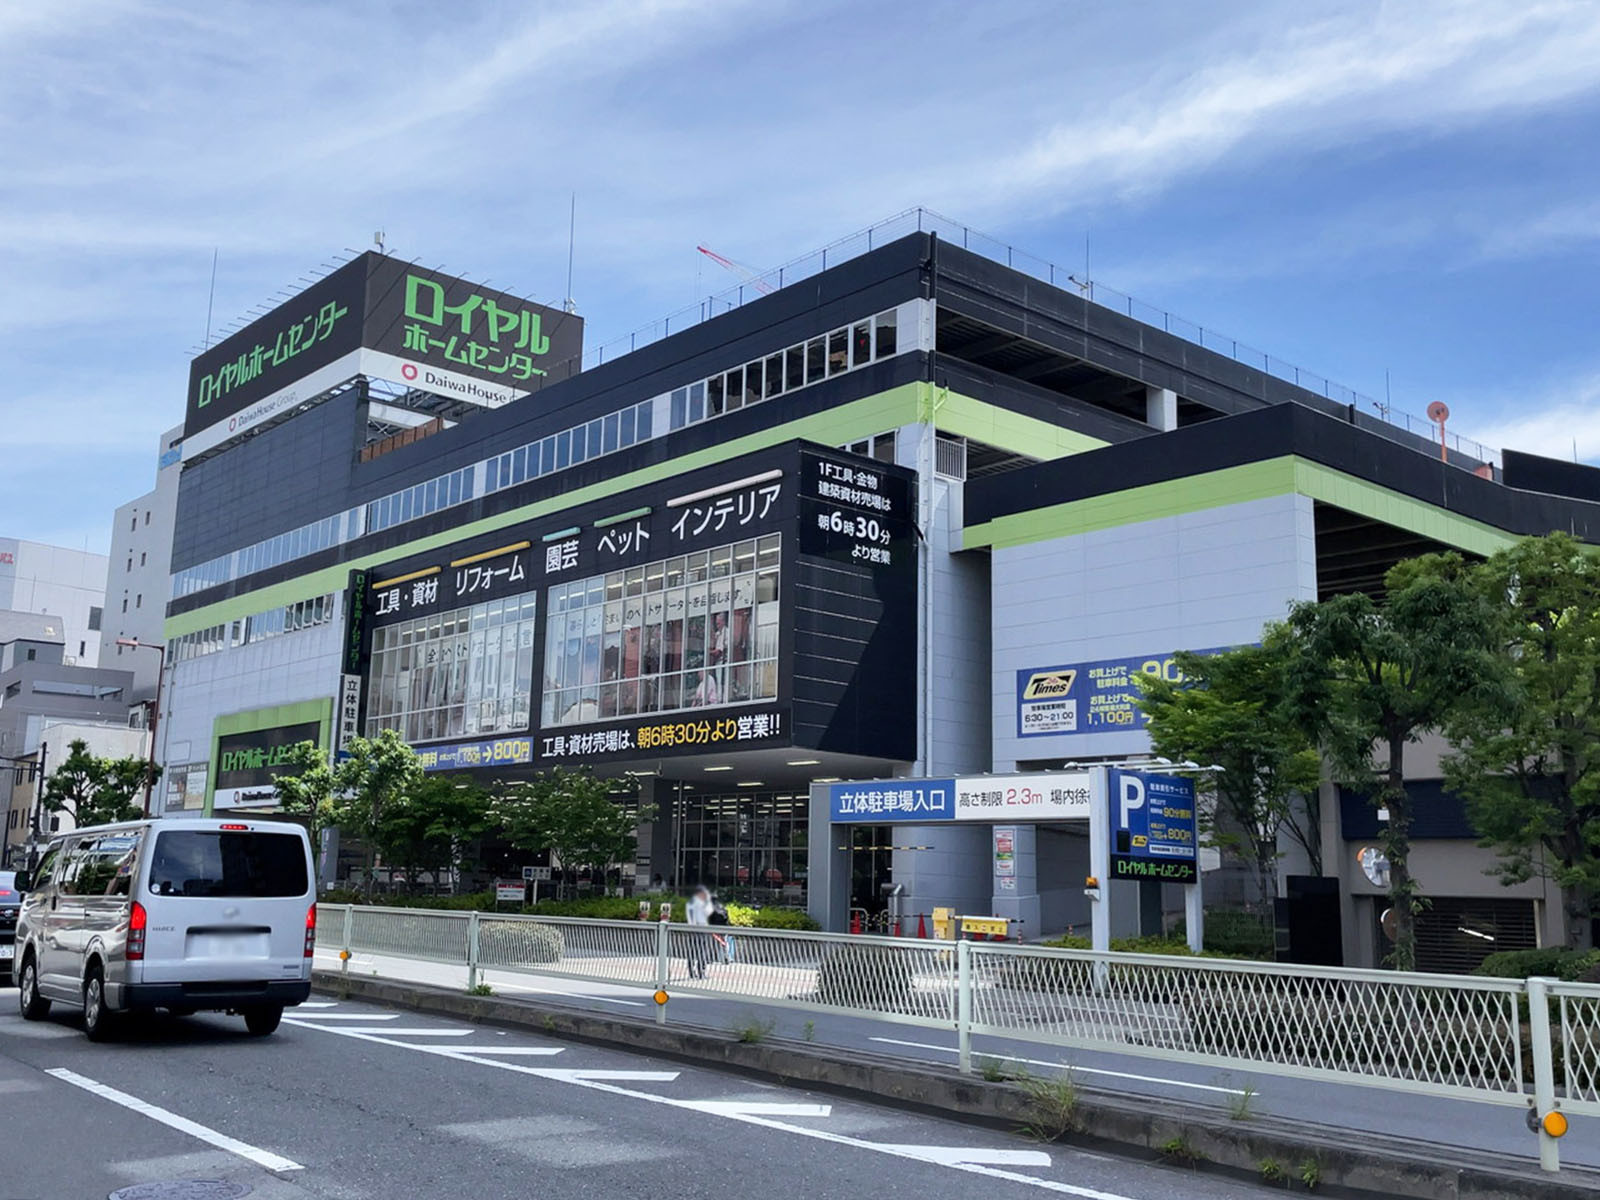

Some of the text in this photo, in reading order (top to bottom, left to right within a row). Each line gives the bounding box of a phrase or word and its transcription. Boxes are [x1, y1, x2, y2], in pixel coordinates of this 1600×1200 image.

[404, 275, 550, 354] ロイヤル
[198, 301, 348, 408] ロイヤルホームセンター
[403, 323, 548, 381] ホームセンター
[425, 372, 506, 403] DaiwaHouse
[671, 484, 782, 540] インテリア
[818, 481, 891, 511] 建築資材売場は
[598, 521, 650, 555] ペット
[818, 511, 891, 545] 朝6時30分
[545, 540, 579, 574] 園芸
[852, 544, 891, 565] より営業
[456, 555, 525, 596] リフォーム
[375, 581, 439, 616] 工具・資材
[1032, 680, 1068, 696] Times
[839, 789, 946, 814] 立体駐車場入口
[959, 791, 1003, 808] 高さ制限
[1006, 788, 1043, 805] 2.3m
[1119, 774, 1145, 829] P
[1117, 860, 1194, 878] ロイヤルホームセンター
